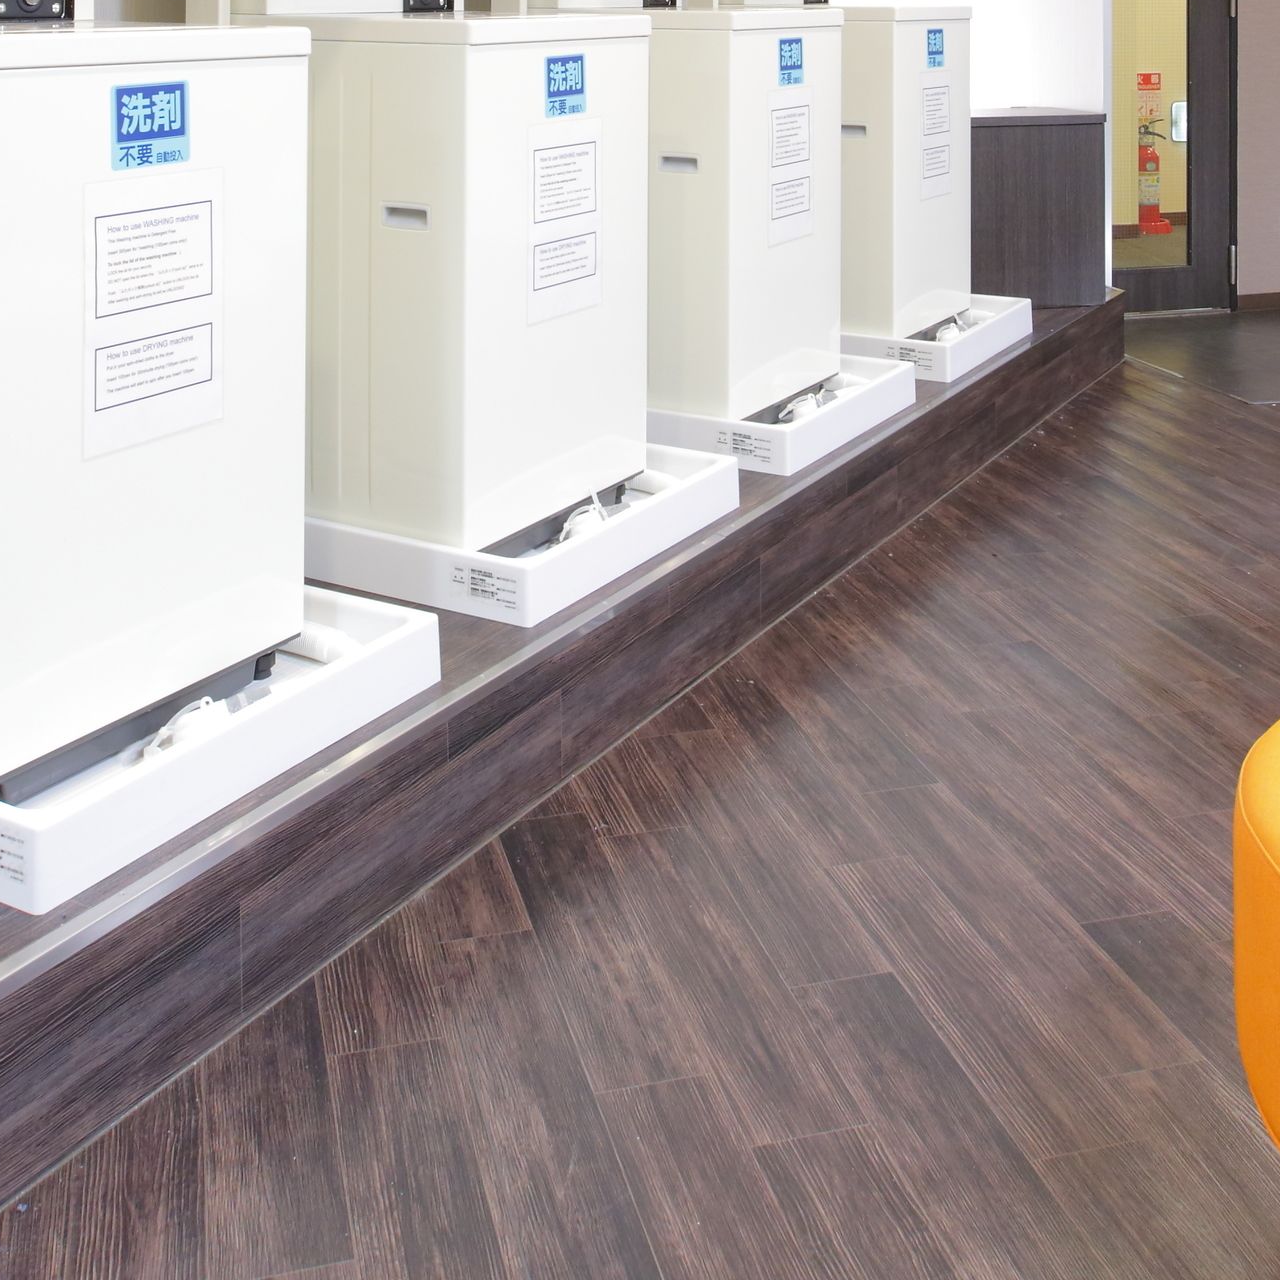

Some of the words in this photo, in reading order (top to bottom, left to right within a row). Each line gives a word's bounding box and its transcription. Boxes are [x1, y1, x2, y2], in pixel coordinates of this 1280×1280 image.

[549, 60, 582, 93] 洗剤
[120, 89, 181, 136] 洗剤
[549, 98, 567, 116] 不要
[119, 144, 153, 167] 不要
